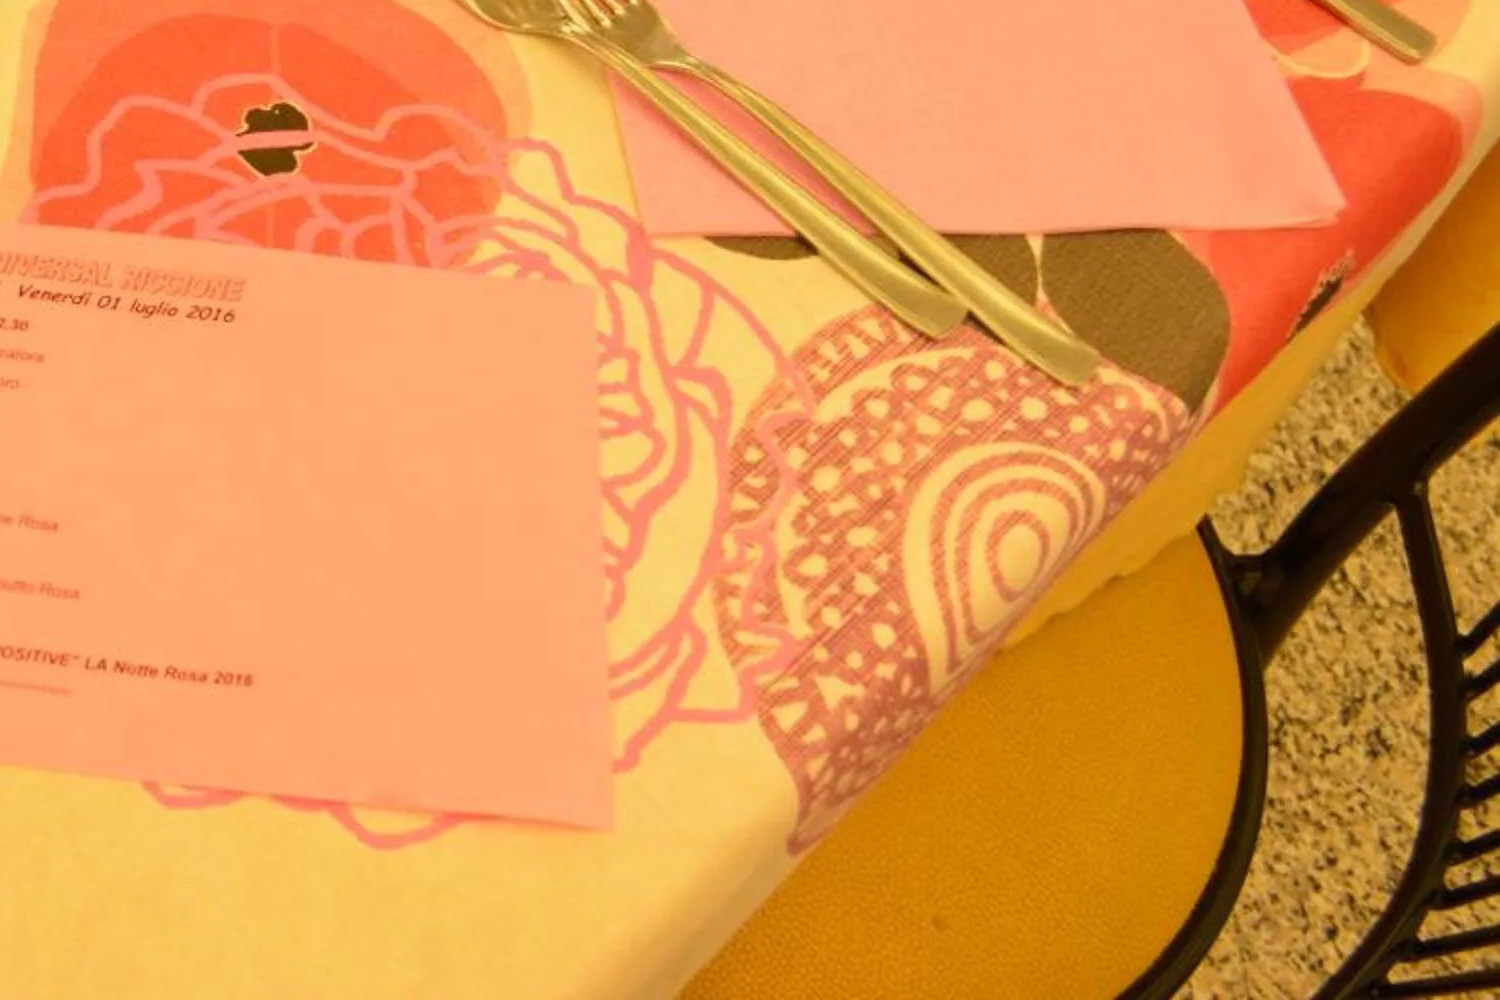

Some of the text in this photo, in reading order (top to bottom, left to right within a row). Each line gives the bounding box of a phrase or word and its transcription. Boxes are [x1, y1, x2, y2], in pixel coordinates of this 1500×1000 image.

[118, 265, 247, 303] RICCIONE
[97, 294, 122, 311] 01
[129, 297, 179, 319] luglio
[185, 305, 236, 324] 2016
[17, 513, 59, 533] Rosa
[39, 582, 81, 600] Rosa
[84, 656, 107, 672] LA
[113, 659, 159, 678] Notte
[164, 664, 208, 683] Rosa
